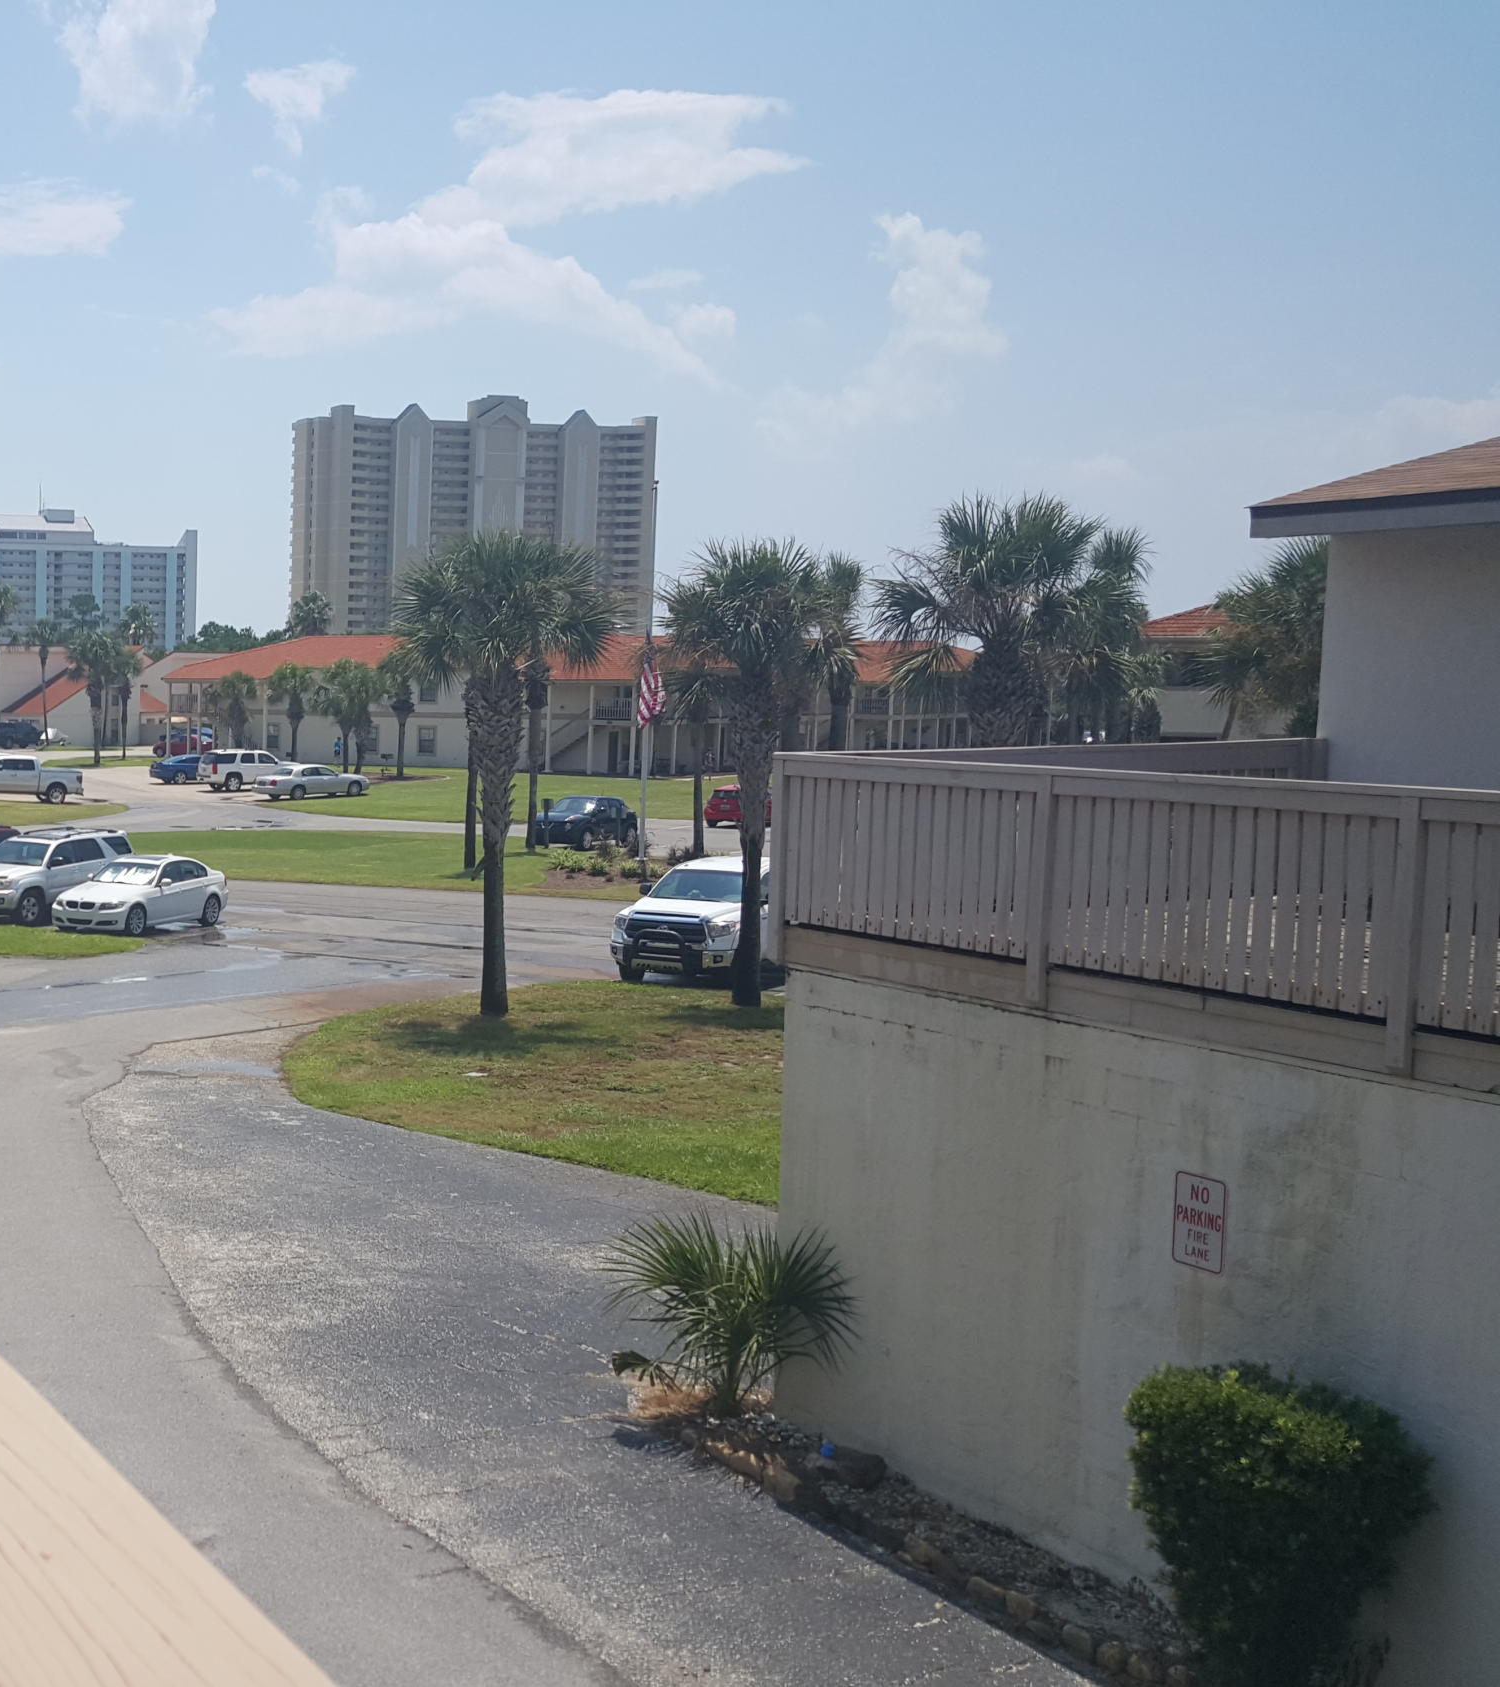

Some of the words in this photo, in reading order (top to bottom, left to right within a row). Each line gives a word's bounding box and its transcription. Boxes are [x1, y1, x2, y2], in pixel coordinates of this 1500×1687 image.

[1191, 1184, 1210, 1204] NO
[1176, 1204, 1222, 1232] PARKING
[1187, 1228, 1209, 1246] FIRE
[1185, 1244, 1210, 1262] LANE
